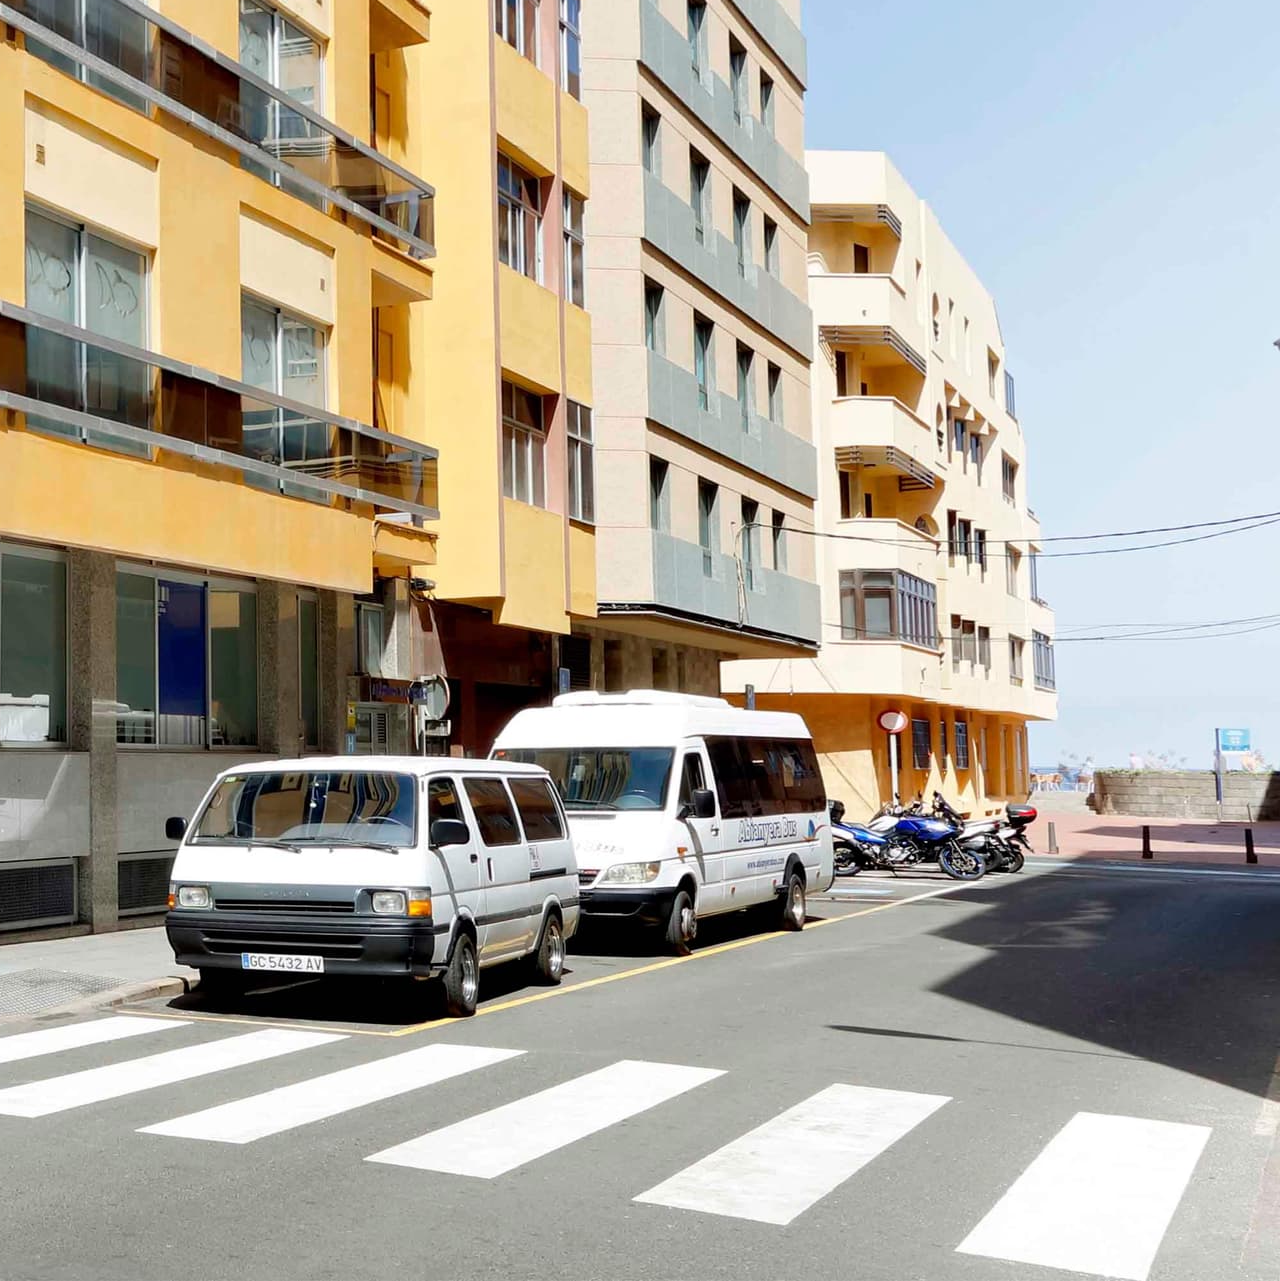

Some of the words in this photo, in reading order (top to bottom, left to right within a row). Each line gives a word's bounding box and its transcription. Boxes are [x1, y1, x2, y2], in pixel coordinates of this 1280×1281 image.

[737, 820, 782, 847] Abianyera
[783, 816, 798, 837] Bus
[249, 955, 266, 968] GC
[268, 956, 303, 970] 5432
[306, 958, 322, 971] AV
